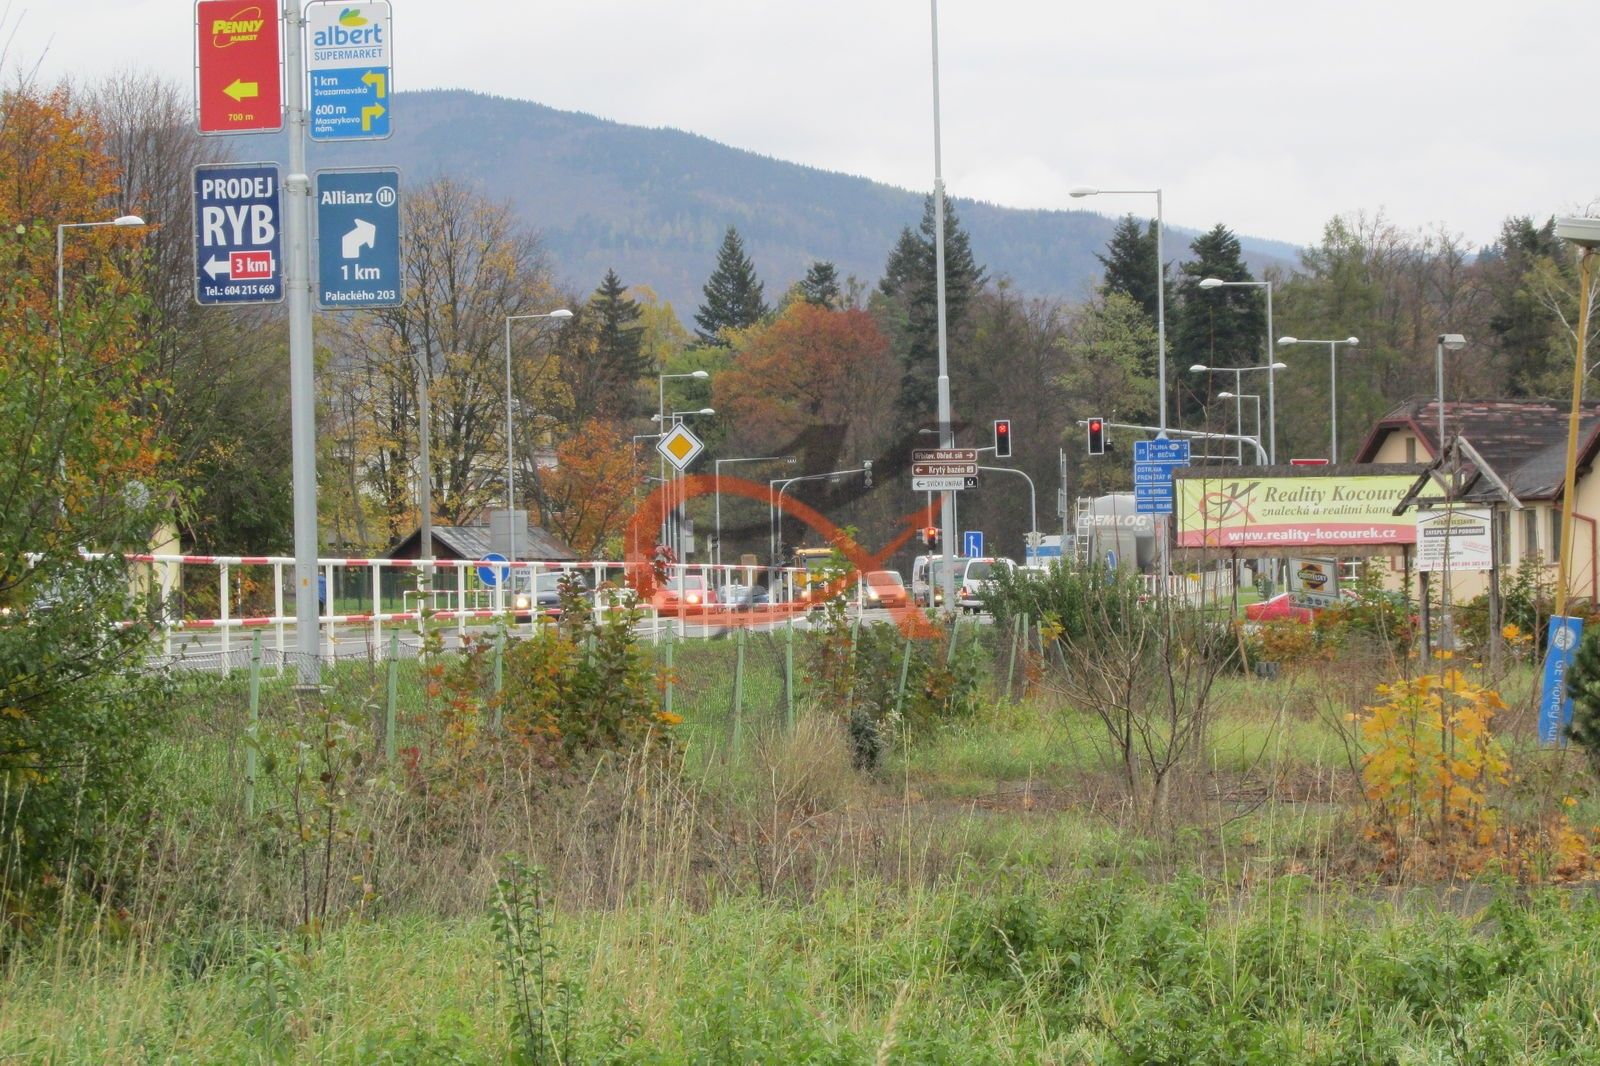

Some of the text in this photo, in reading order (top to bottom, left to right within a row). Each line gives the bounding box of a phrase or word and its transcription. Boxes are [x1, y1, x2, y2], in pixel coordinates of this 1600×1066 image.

[212, 20, 264, 34] PENNY
[230, 34, 258, 42] MARKET
[314, 23, 383, 46] albert
[314, 49, 382, 61] SUPERMARKET
[314, 75, 338, 87] 1 km
[315, 105, 346, 115] 600 m
[228, 113, 243, 121] 700
[315, 124, 334, 133] nám.
[202, 177, 273, 200] PRODEJ
[321, 190, 373, 205] Allianz
[203, 205, 275, 247] RYB
[235, 256, 268, 273] 3 km
[341, 264, 380, 280] 1 km
[205, 285, 275, 296] Tel.: 604 215 669
[325, 290, 396, 301] Palackého 203
[928, 465, 965, 474] Krytý bazén
[1264, 485, 1326, 506] Reality
[1332, 483, 1413, 502] Kocoure
[1261, 505, 1310, 517] znalecká
[1313, 508, 1320, 516] a
[1322, 504, 1362, 516] realitní
[1228, 526, 1397, 542] www.reality-kocourek.cz
